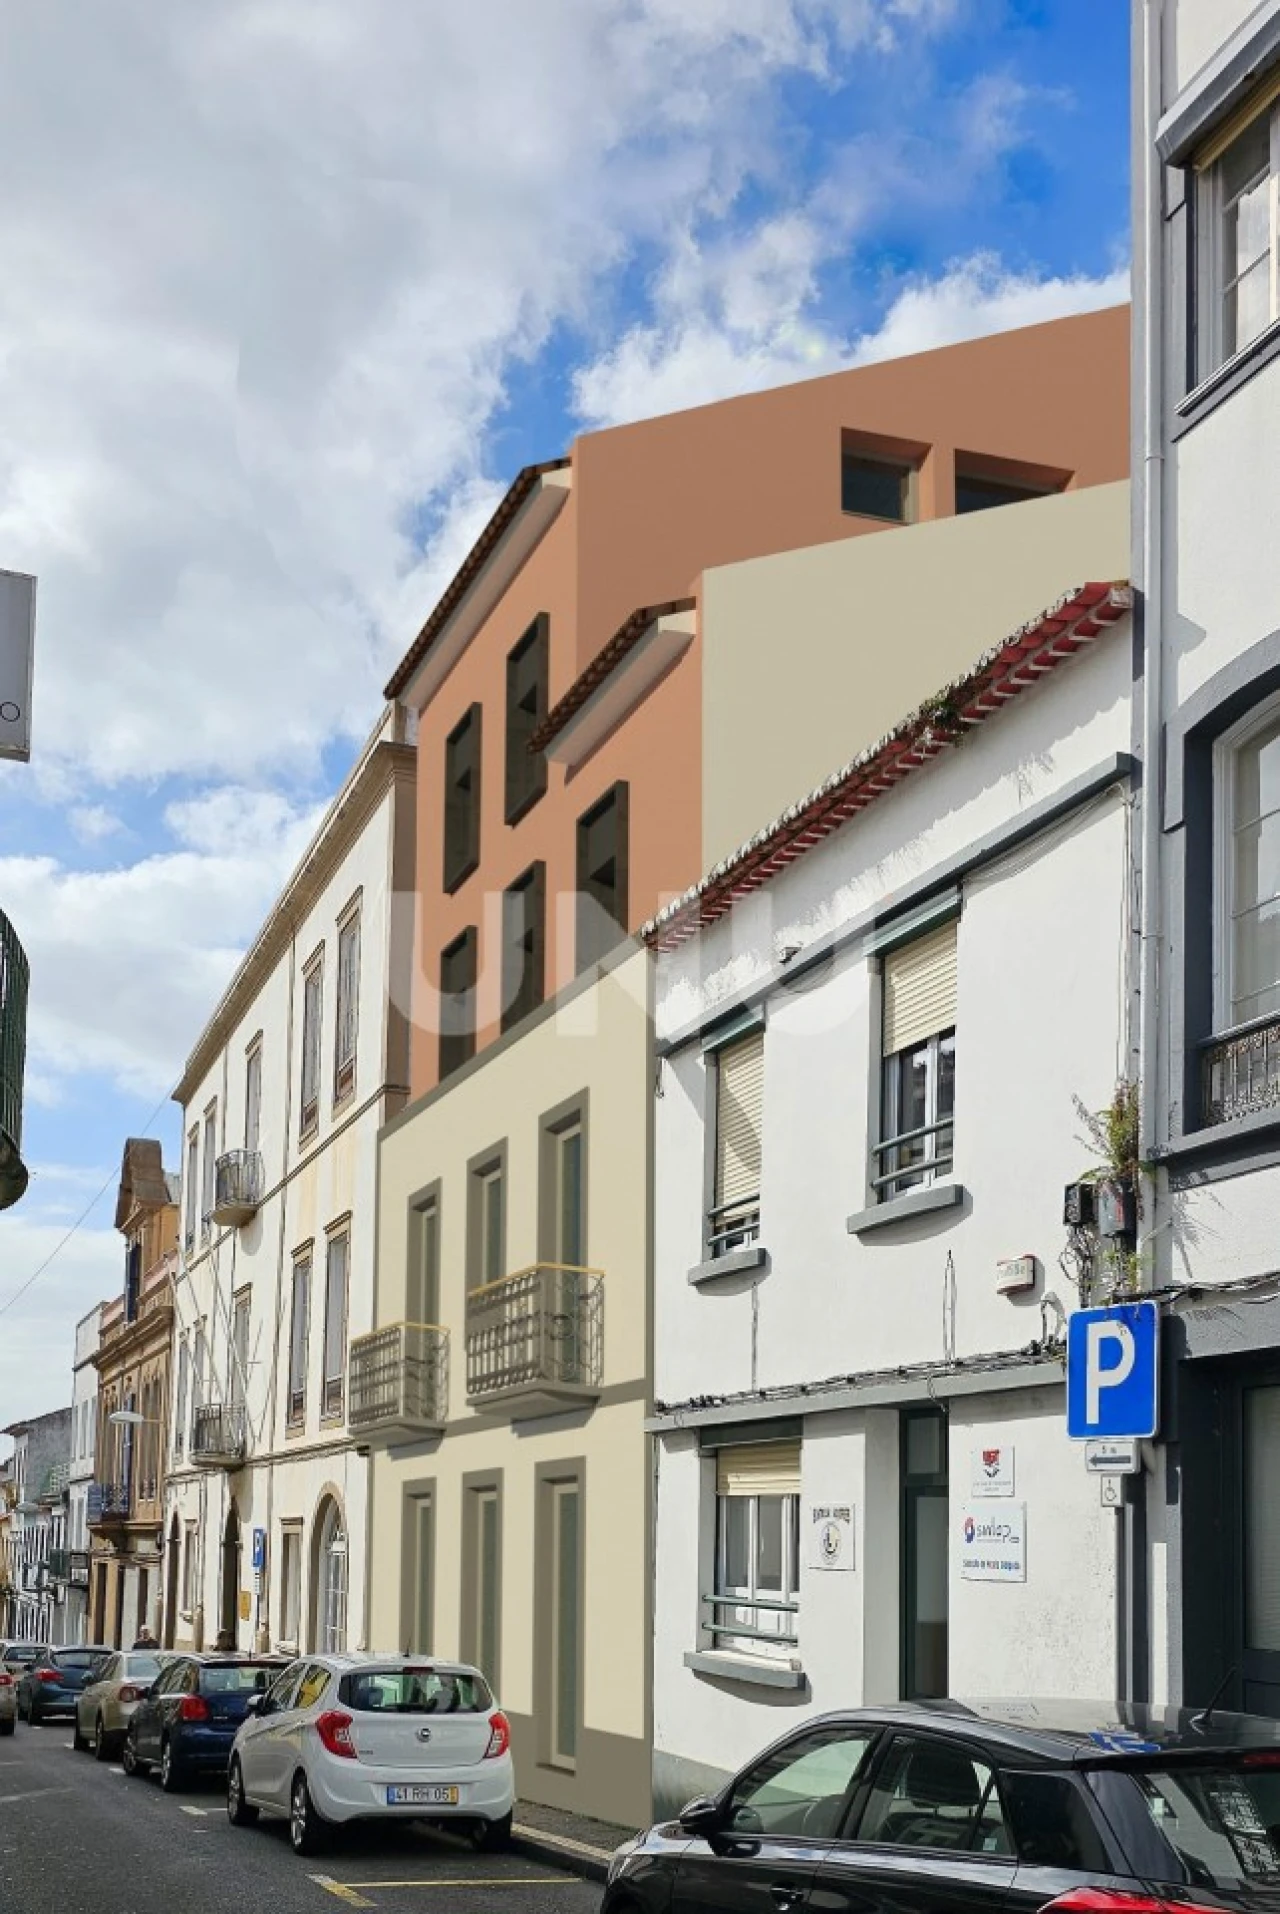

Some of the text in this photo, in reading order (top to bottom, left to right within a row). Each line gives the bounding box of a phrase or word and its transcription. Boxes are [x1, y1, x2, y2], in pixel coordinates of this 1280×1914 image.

[1086, 1320, 1135, 1424] P
[396, 1788, 449, 1801] 41 RH 05
